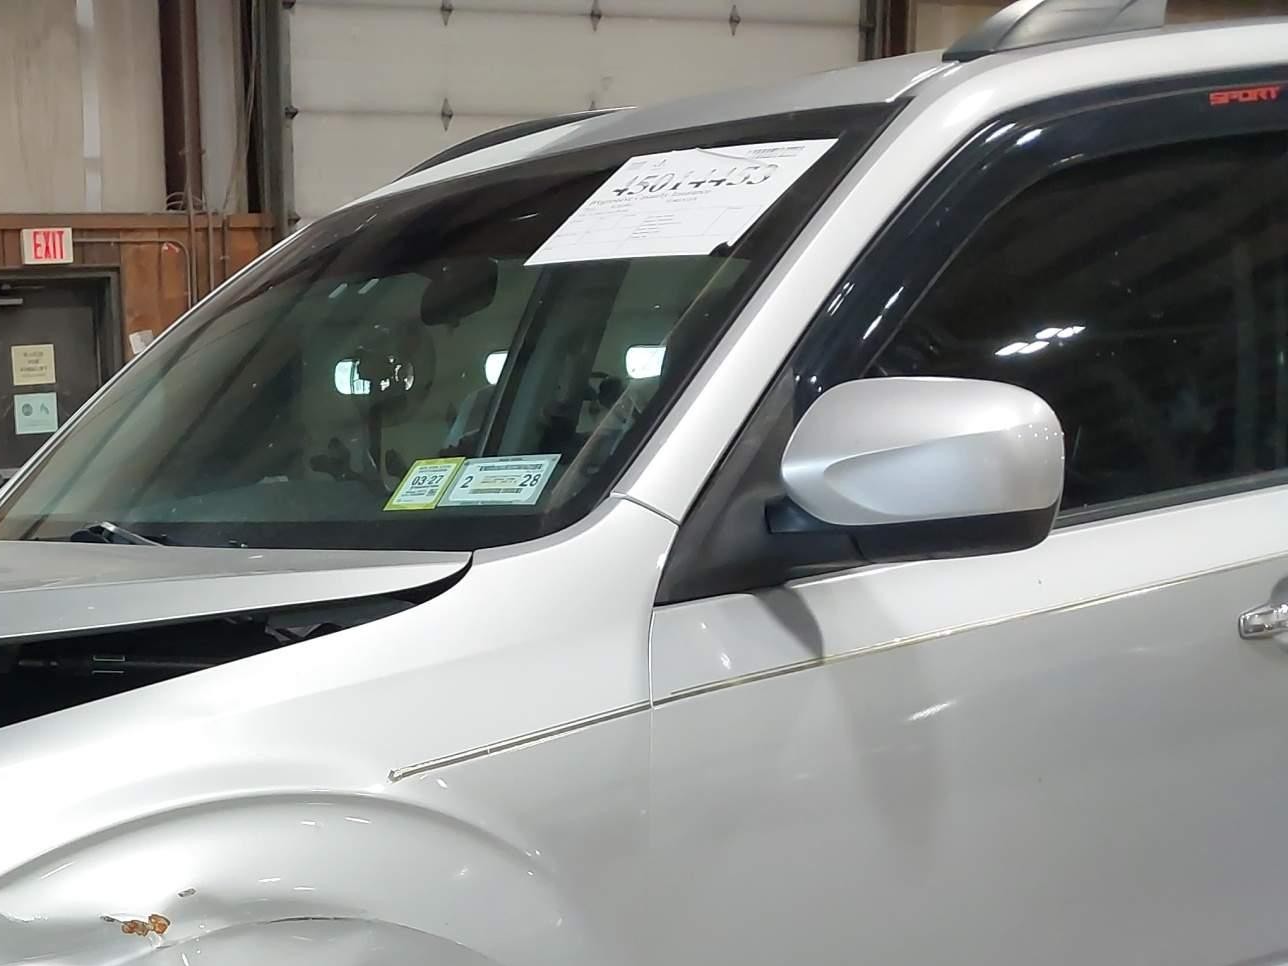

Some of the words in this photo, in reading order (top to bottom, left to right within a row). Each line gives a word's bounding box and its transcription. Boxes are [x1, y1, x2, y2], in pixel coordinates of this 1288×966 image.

[1209, 86, 1281, 106] SPORT
[33, 230, 65, 259] EXIT
[460, 475, 474, 488] 2
[519, 474, 542, 487] 28
